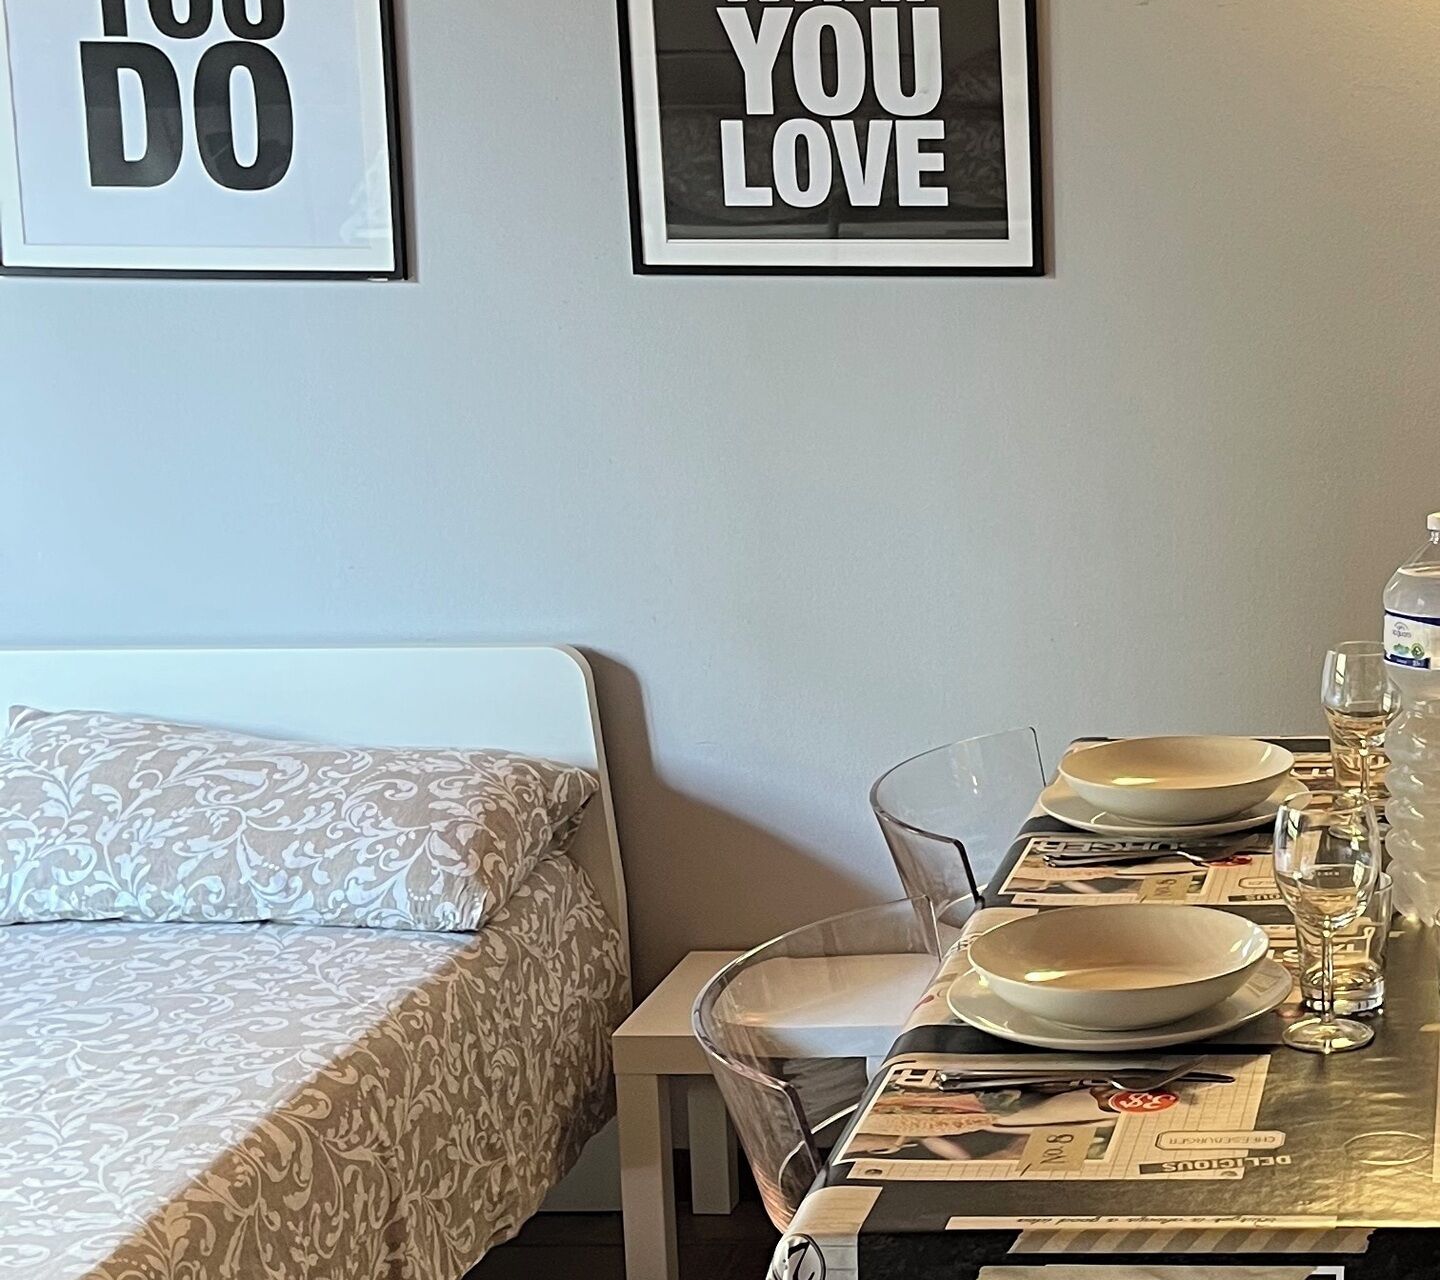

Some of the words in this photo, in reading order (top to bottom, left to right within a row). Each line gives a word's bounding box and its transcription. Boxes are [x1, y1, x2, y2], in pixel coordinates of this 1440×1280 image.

[716, 4, 943, 118] YOU
[80, 40, 294, 192] DO
[720, 119, 950, 208] LOVE
[1046, 1133, 1075, 1144] 8
[1161, 1154, 1293, 1173] DELICIOUS
